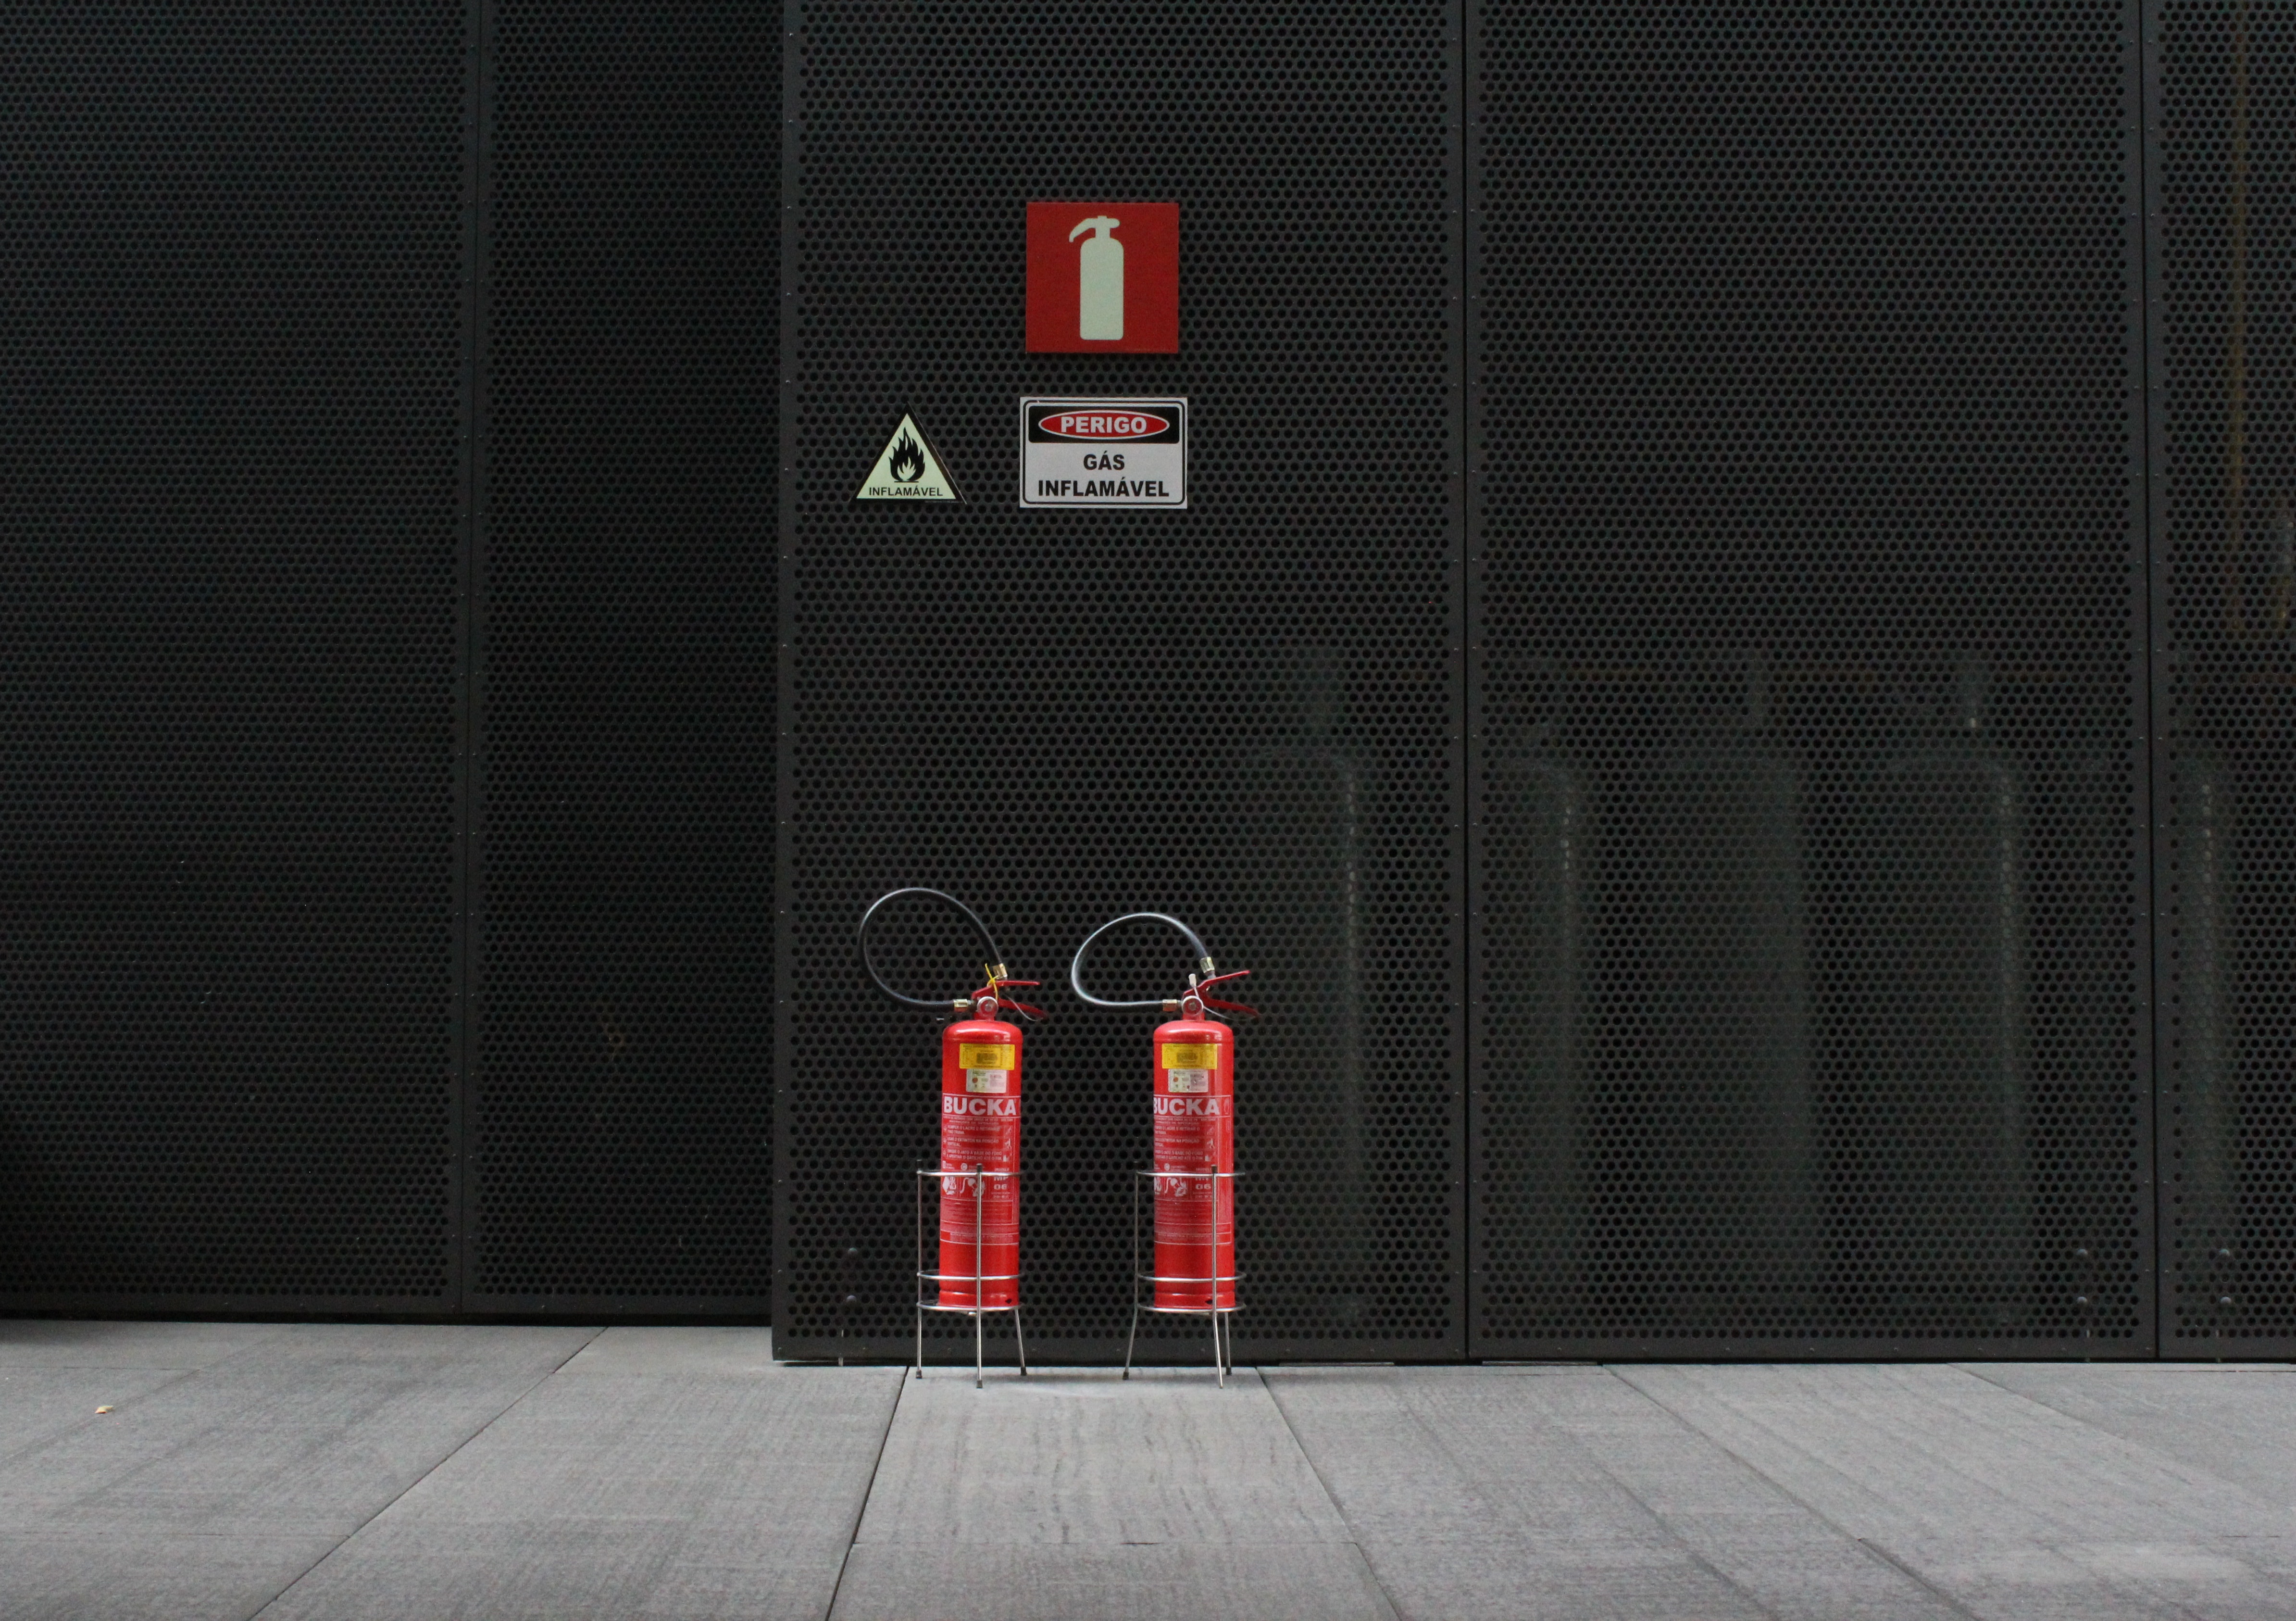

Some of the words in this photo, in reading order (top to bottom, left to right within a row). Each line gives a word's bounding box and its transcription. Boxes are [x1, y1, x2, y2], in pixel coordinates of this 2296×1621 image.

[1061, 416, 1147, 433] PERIGO
[1083, 451, 1125, 470] GÁS
[869, 485, 943, 496] INFLAMÁVEL
[1038, 477, 1169, 497] INFLAMÁVEL
[944, 1096, 1016, 1115] BUCKA
[1153, 1097, 1220, 1115] BUCKA
